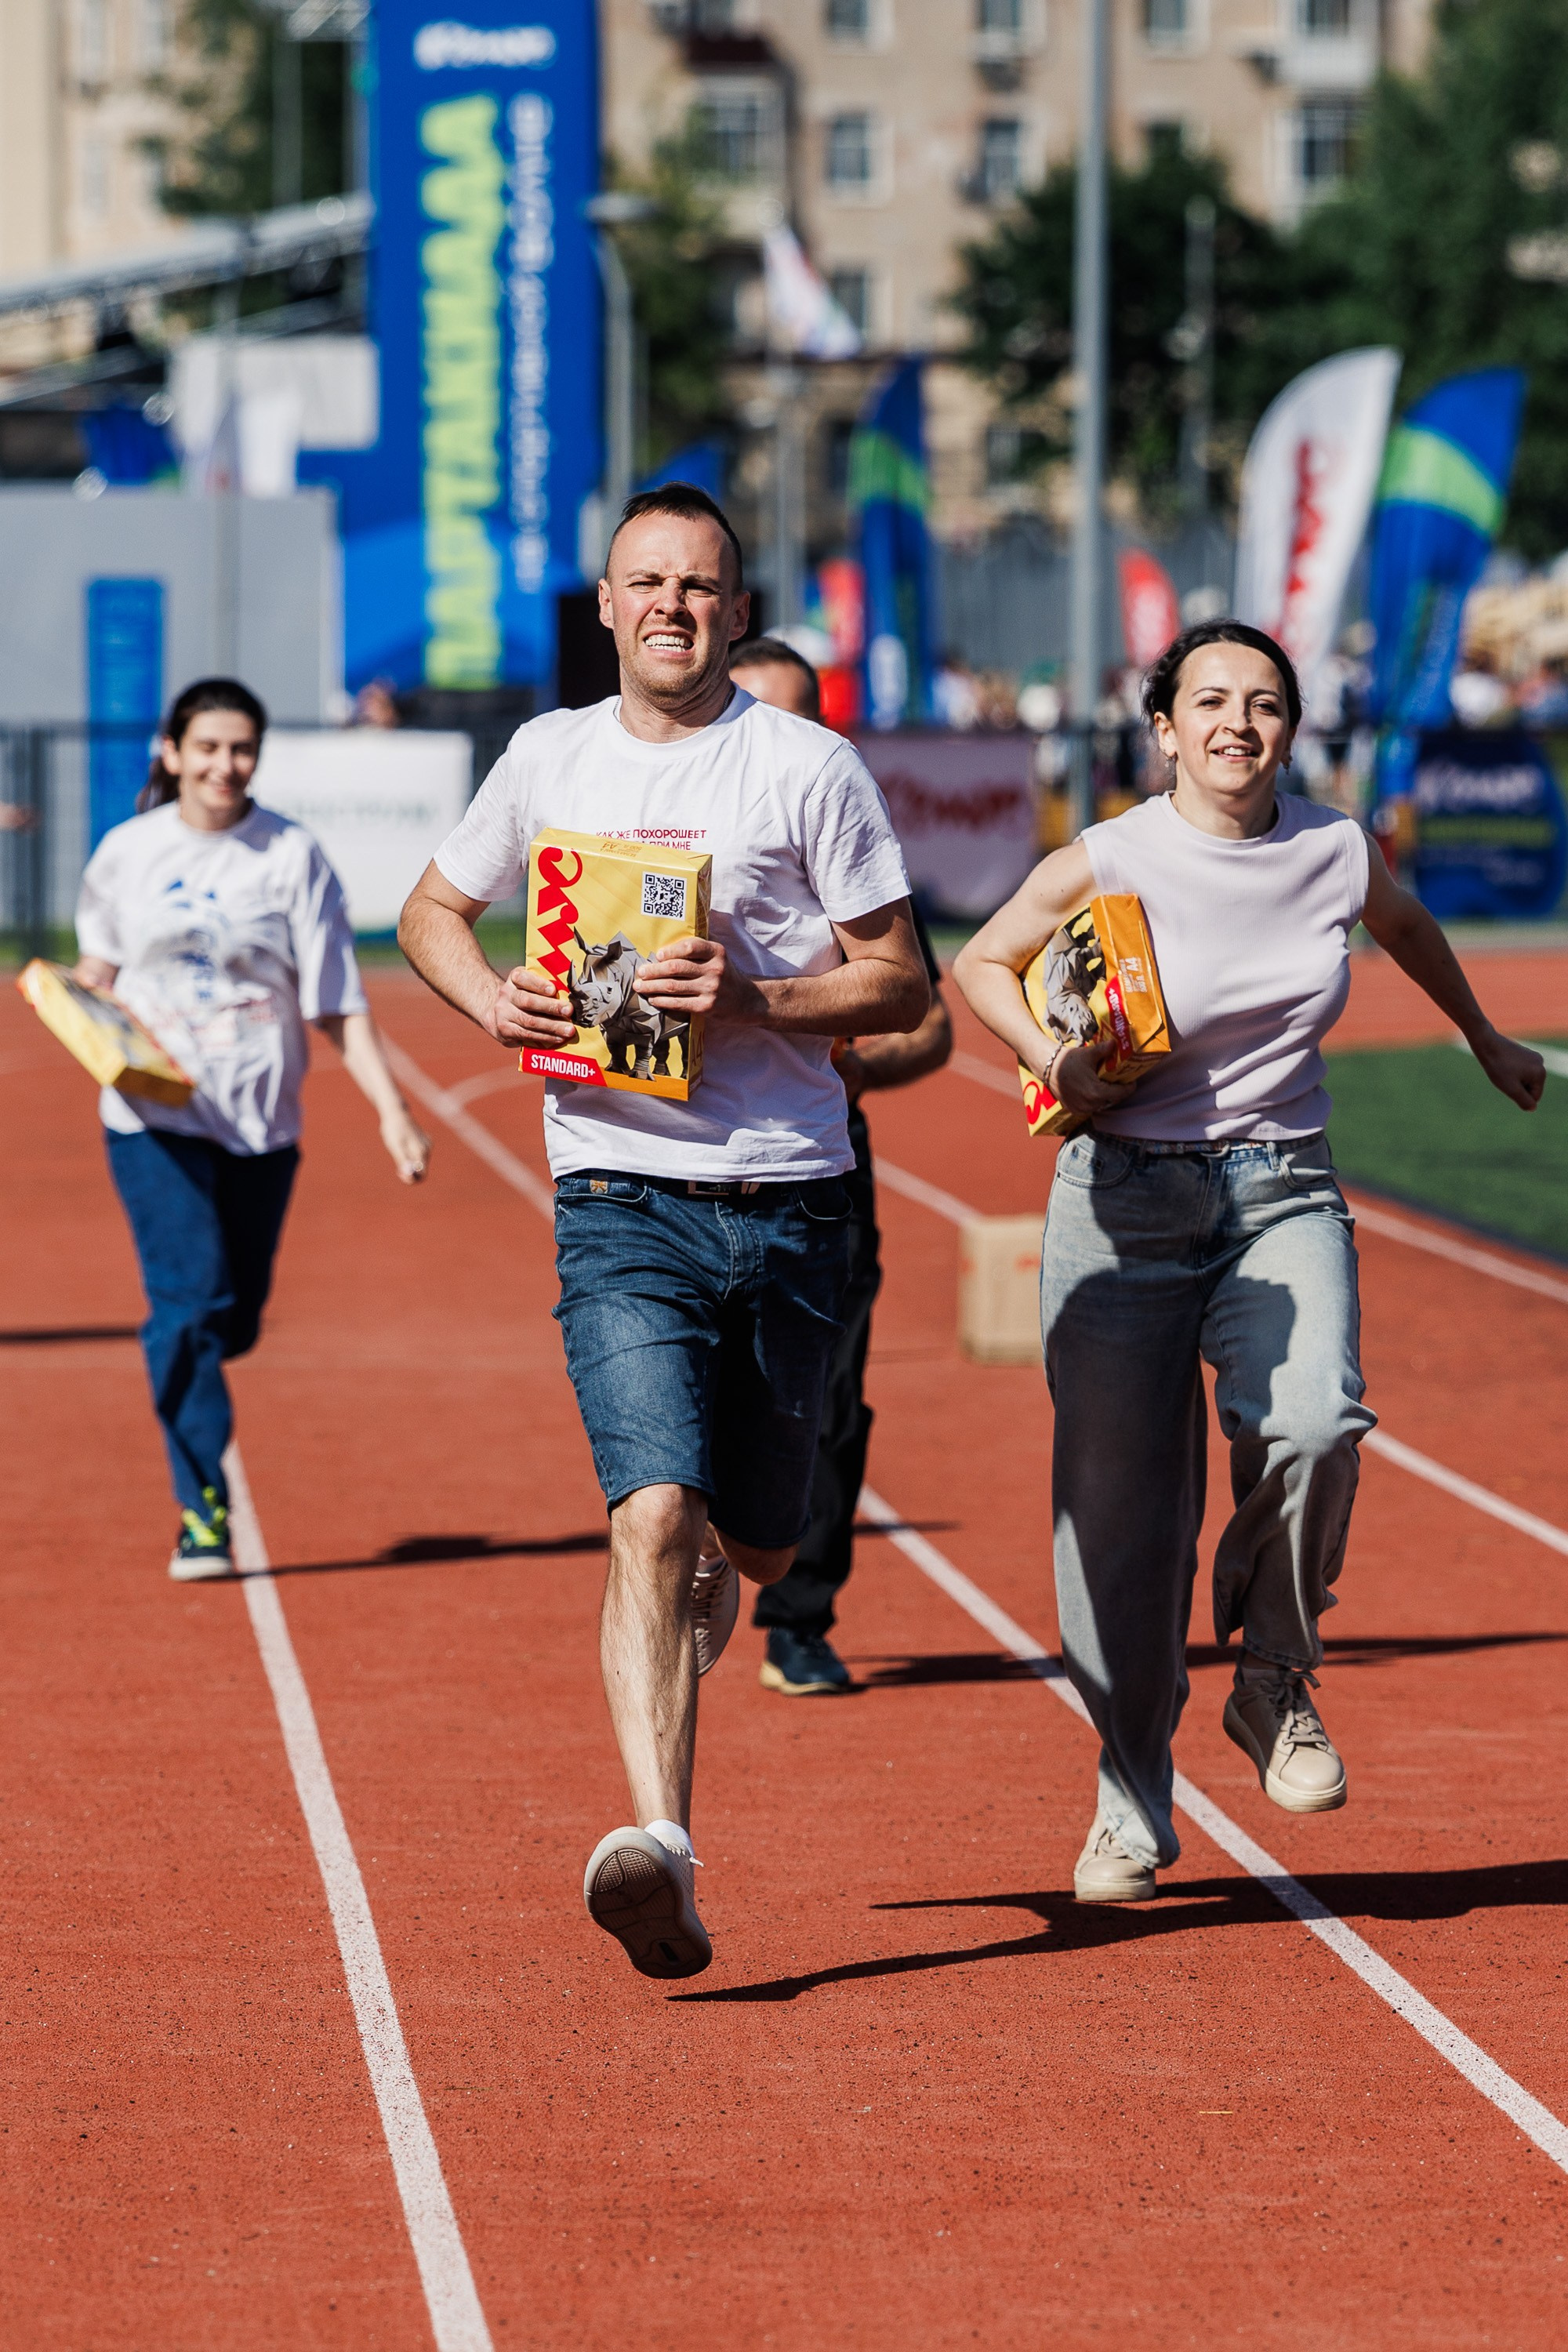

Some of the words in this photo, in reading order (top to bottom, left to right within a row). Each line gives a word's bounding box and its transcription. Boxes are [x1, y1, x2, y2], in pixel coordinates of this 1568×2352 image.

[616, 830, 630, 839] ЖЕ
[633, 829, 707, 839] ПОХОРОШЕЕТ
[672, 840, 691, 851] МНЕ
[1108, 987, 1129, 1051] STANDARD+
[531, 1054, 596, 1078] STANDARD+
